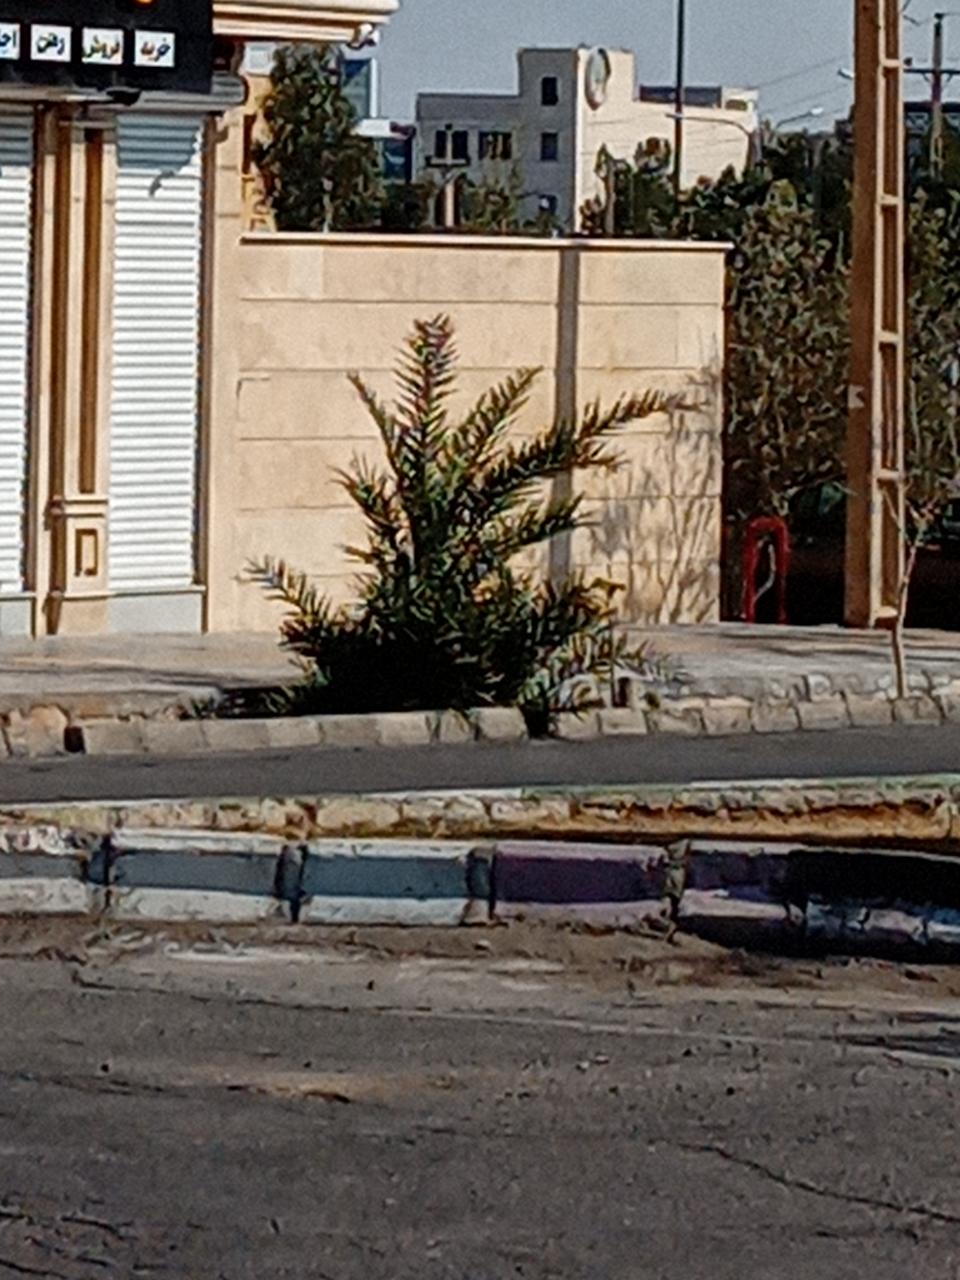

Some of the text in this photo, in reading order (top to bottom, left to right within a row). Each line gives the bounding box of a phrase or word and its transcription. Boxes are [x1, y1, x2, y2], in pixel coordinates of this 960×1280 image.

[36, 32, 65, 56] رهن
[83, 35, 121, 59] فروش
[140, 33, 171, 62] خرید
